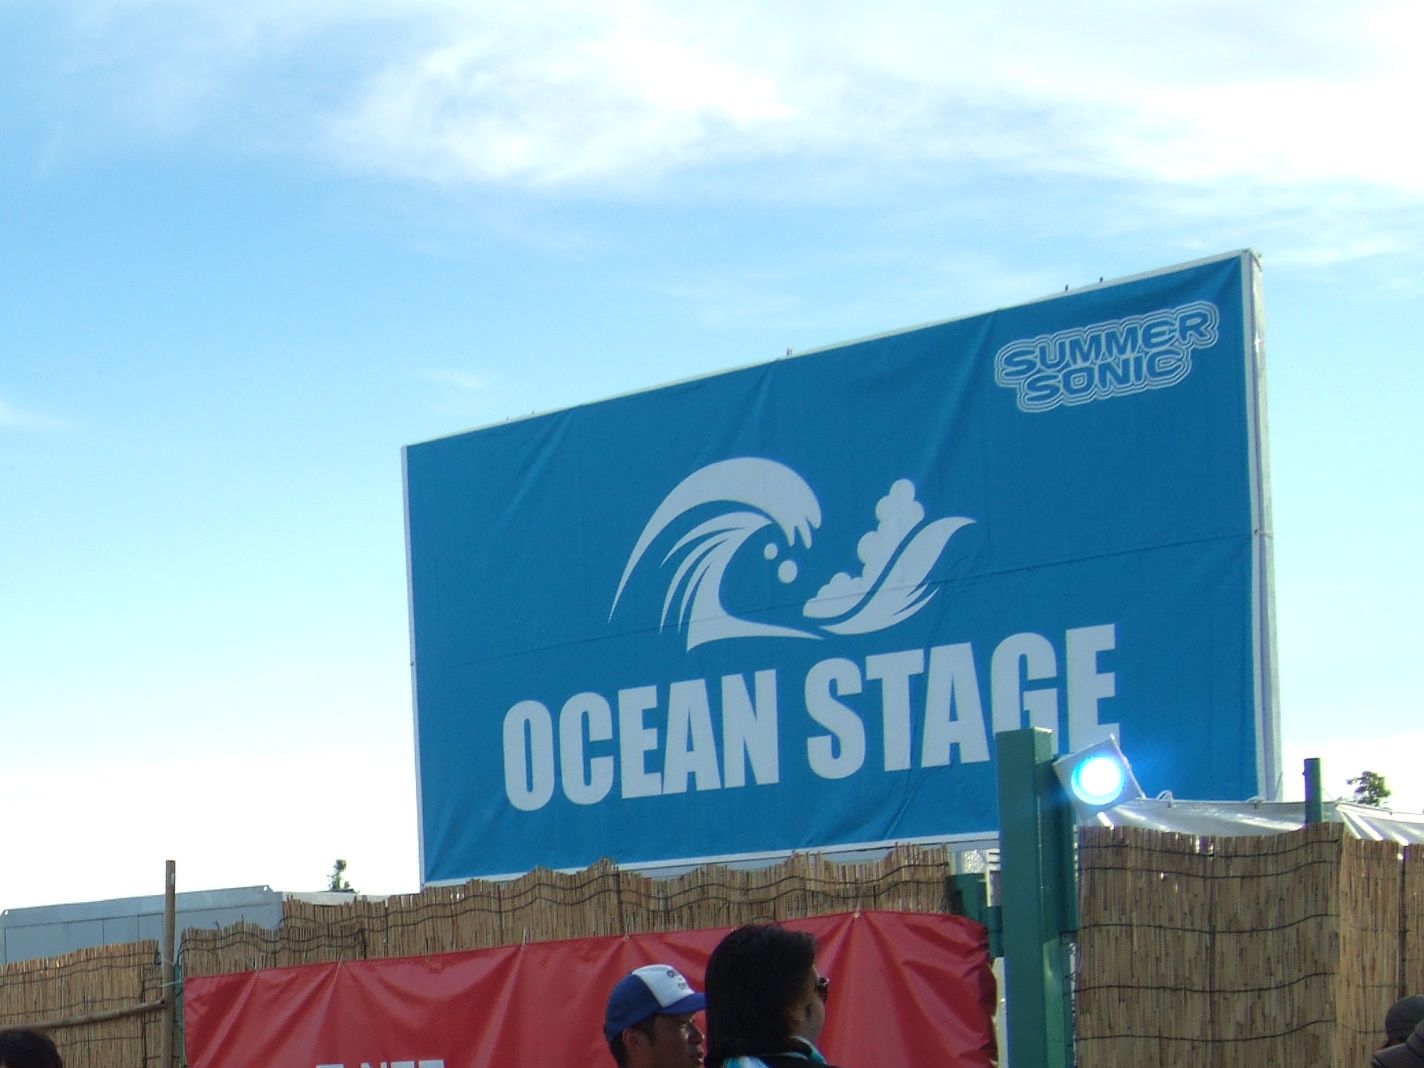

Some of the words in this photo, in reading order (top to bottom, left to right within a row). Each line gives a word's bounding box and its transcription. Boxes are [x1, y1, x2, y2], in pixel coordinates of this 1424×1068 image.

[998, 304, 1216, 385] SUMMER
[1020, 346, 1190, 409] SONIC
[503, 669, 779, 812] OCEAN
[805, 624, 1120, 780] STAGE
